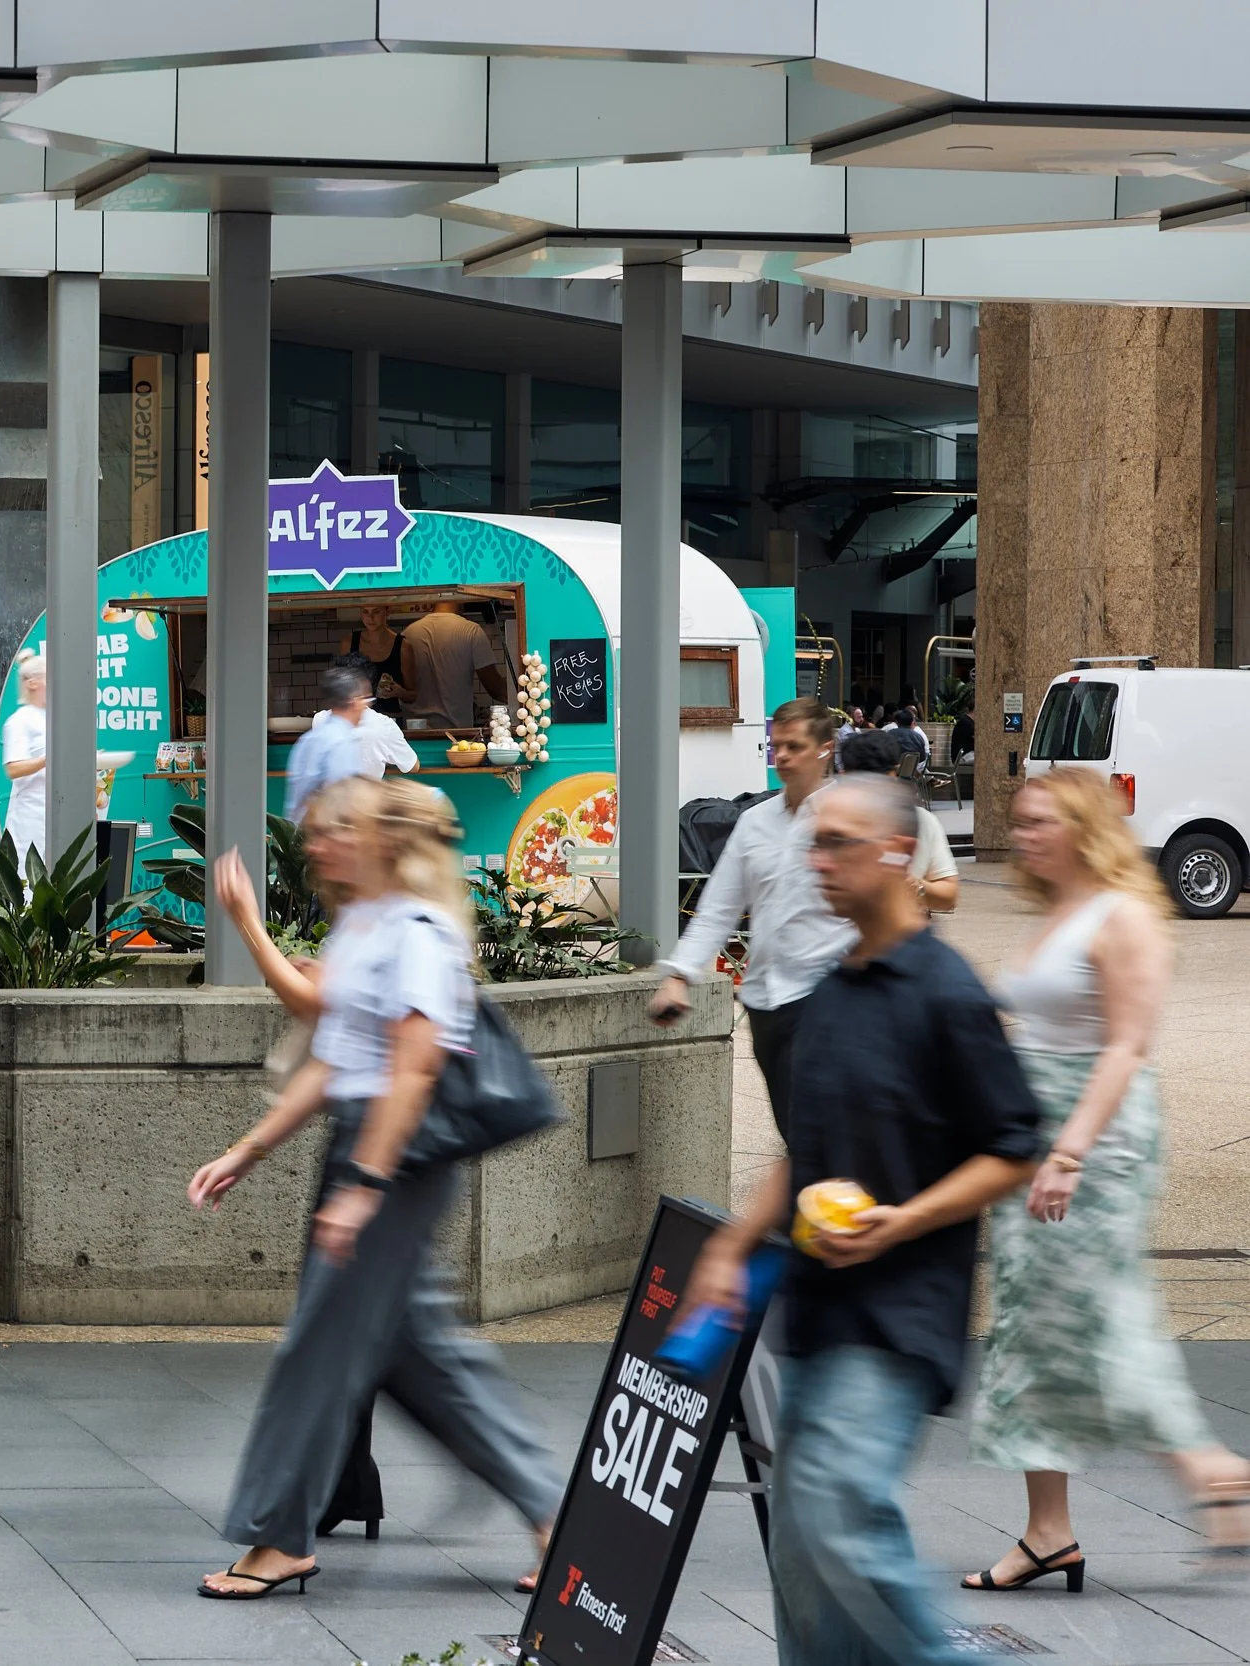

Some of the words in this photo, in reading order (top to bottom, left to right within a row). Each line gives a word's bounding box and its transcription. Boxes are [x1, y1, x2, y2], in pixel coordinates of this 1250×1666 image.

[554, 651, 598, 678] FREE
[556, 674, 603, 709] KEBABS
[97, 709, 162, 731] IGHT
[651, 1265, 666, 1284] PUT
[640, 1298, 659, 1320] FIRST
[617, 1352, 709, 1428] MEMBERSHIP
[575, 1581, 608, 1621] Fitness
[603, 1602, 627, 1635] First
